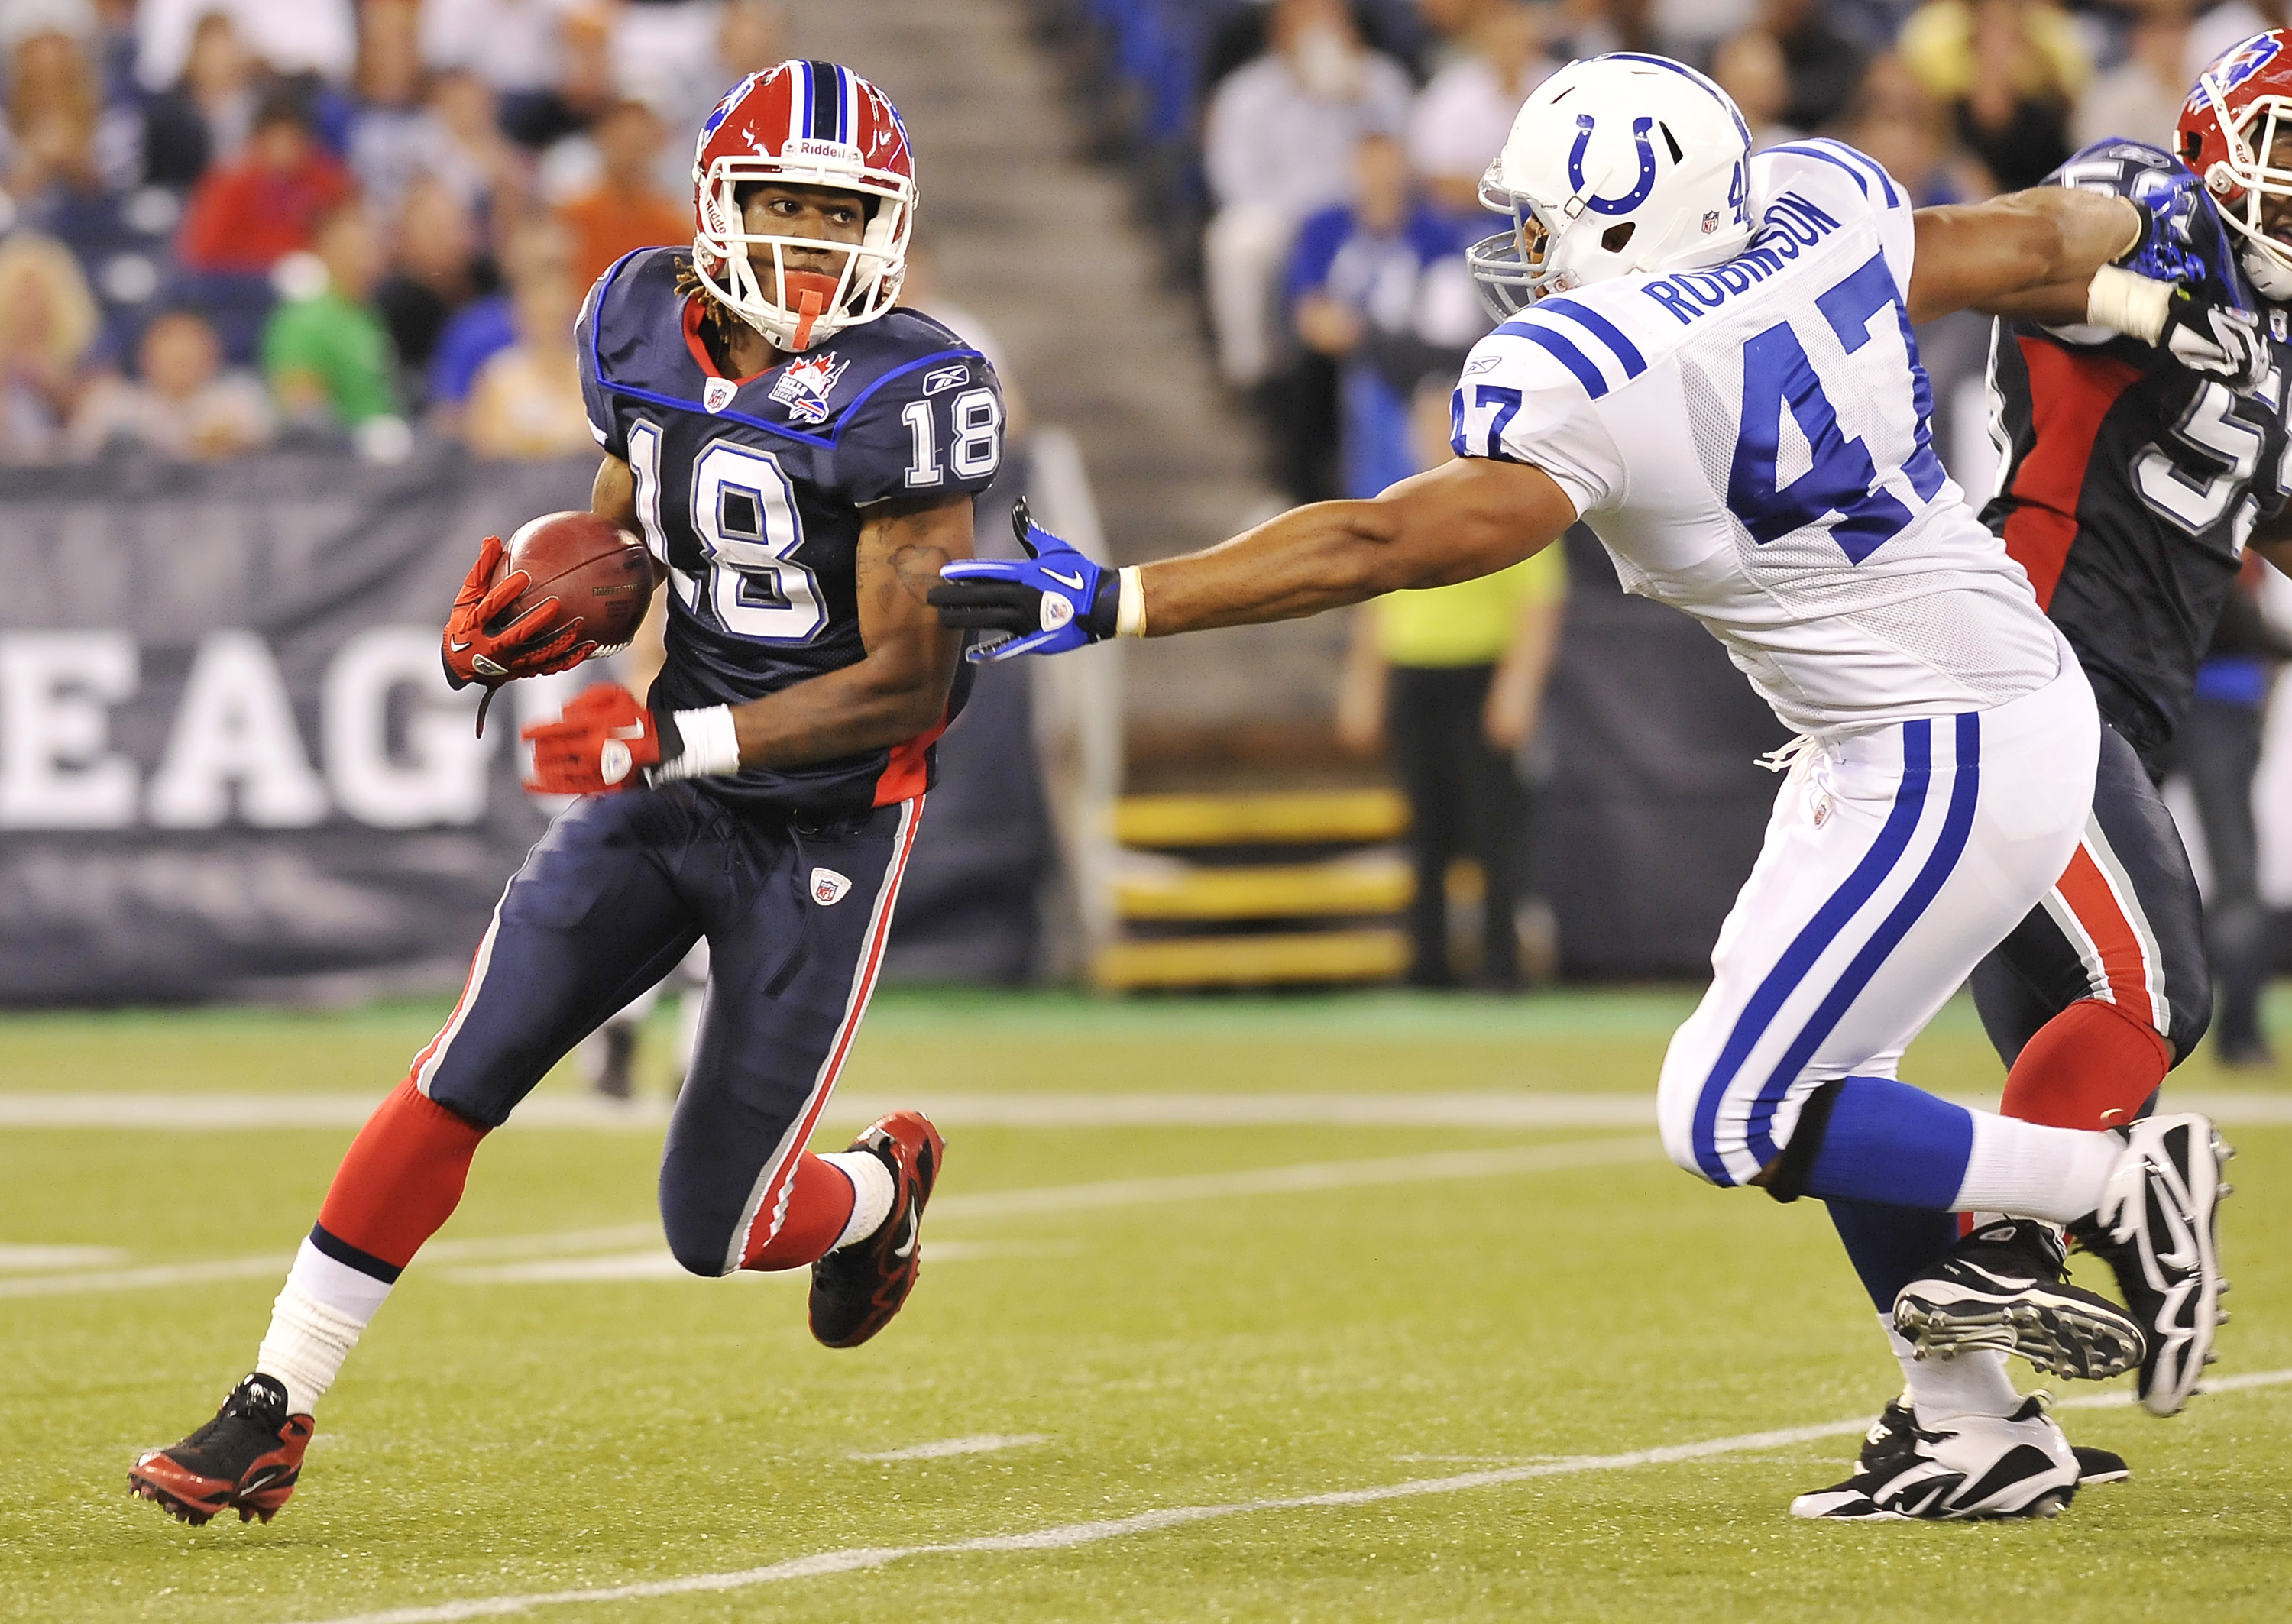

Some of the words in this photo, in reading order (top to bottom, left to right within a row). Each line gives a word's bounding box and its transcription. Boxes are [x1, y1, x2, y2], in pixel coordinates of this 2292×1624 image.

[707, 198, 726, 234] Ridde
[1704, 219, 1717, 232] NFL
[902, 387, 1002, 488] 18
[1451, 384, 1523, 464] 47
[1726, 244, 1947, 567] 47
[628, 418, 830, 644] 18
